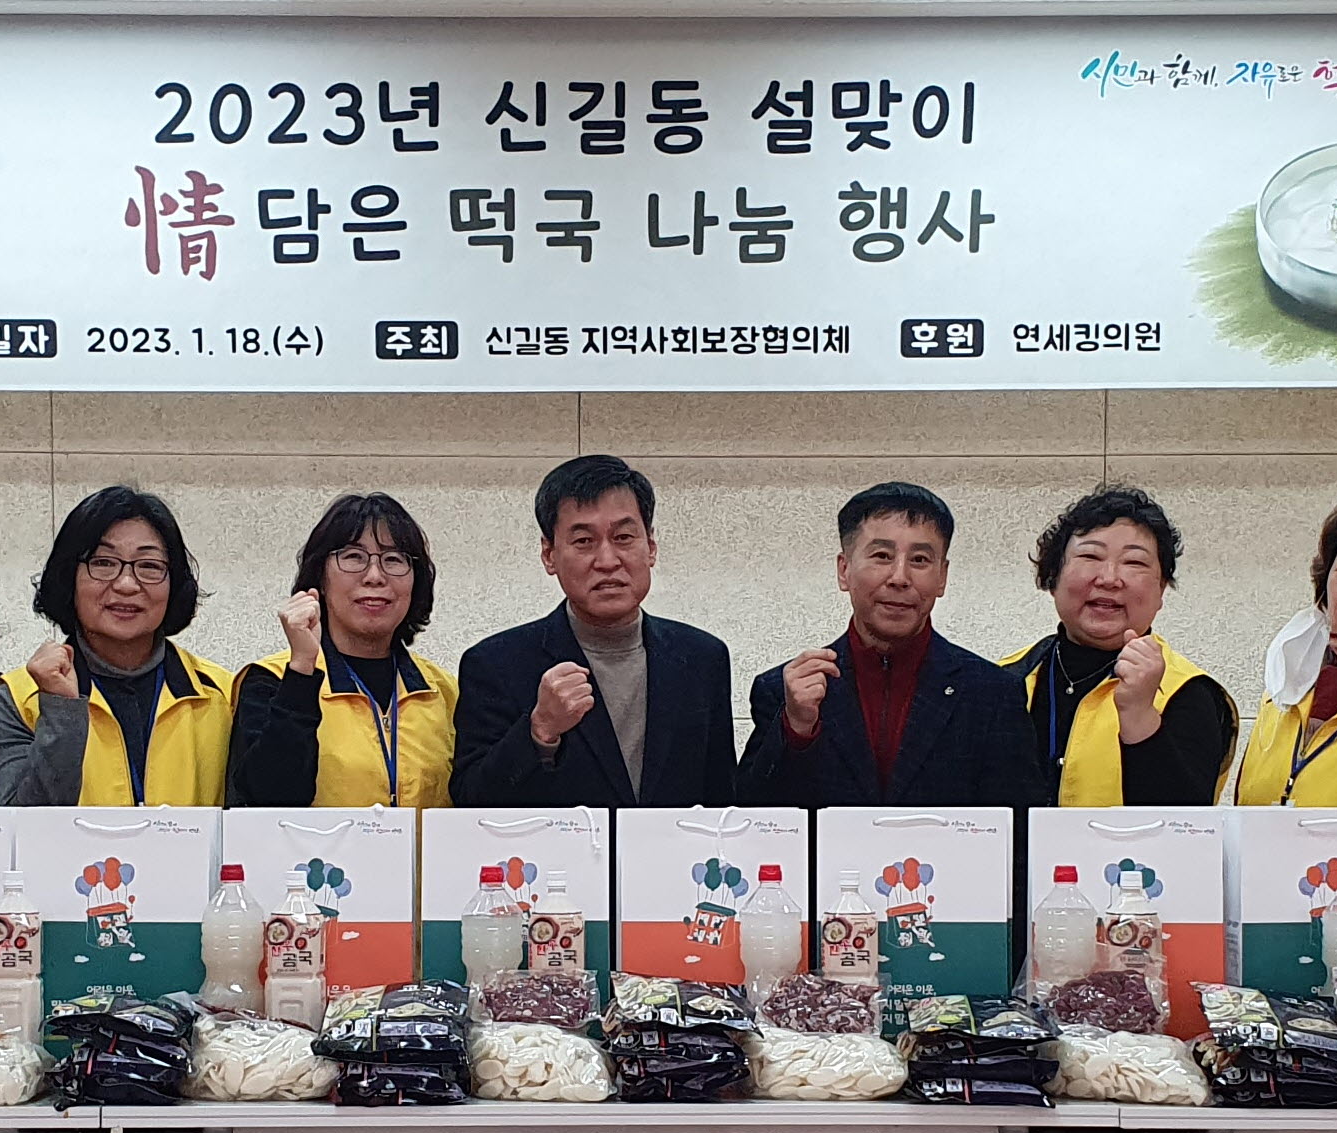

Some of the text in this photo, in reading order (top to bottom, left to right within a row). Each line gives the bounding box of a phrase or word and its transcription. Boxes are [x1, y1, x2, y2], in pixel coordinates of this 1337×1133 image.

[1080, 50, 1160, 98] 시민과
[1226, 61, 1303, 99] 자유로운
[153, 78, 977, 155] 2023년 신길동 설맞이
[123, 164, 234, 281] 情
[257, 181, 997, 264] 담은 떡국 나눔 행사
[86, 325, 182, 357] 2023.
[191, 325, 215, 357] 1.
[384, 324, 851, 357] 주최 신길동 지역사회보장협의체
[908, 322, 1163, 356] 후원 연세킹의원
[1, 951, 32, 967] 곰국
[282, 951, 312, 967] 곰국
[548, 950, 577, 966] 곰국
[840, 950, 870, 966] 곰국
